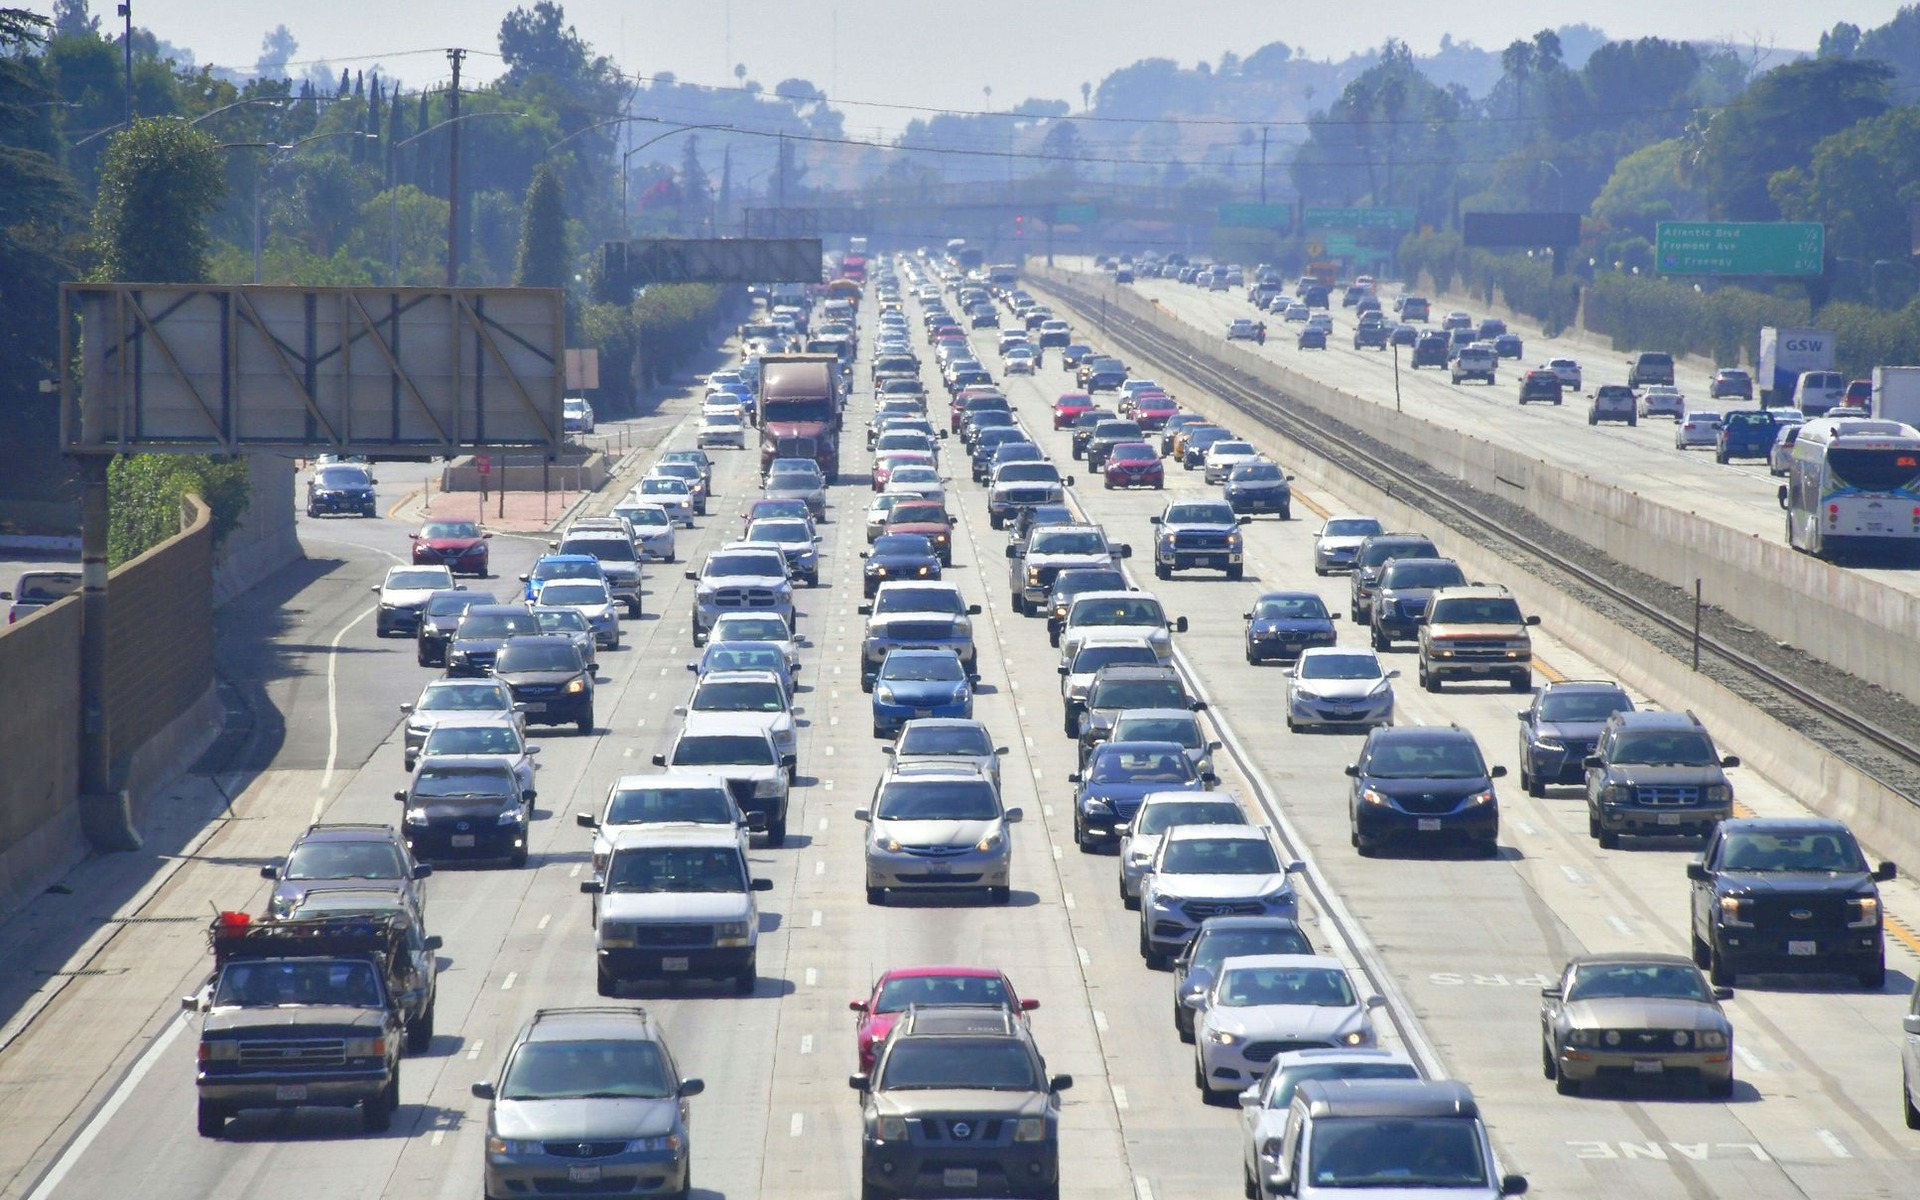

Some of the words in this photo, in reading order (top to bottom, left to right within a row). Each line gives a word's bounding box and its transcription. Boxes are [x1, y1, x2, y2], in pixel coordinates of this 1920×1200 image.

[1663, 227, 1711, 238] Atlantic
[1715, 227, 1740, 238] Blvd
[1786, 339, 1823, 352] GSW
[1565, 1141, 1773, 1162] LANE
